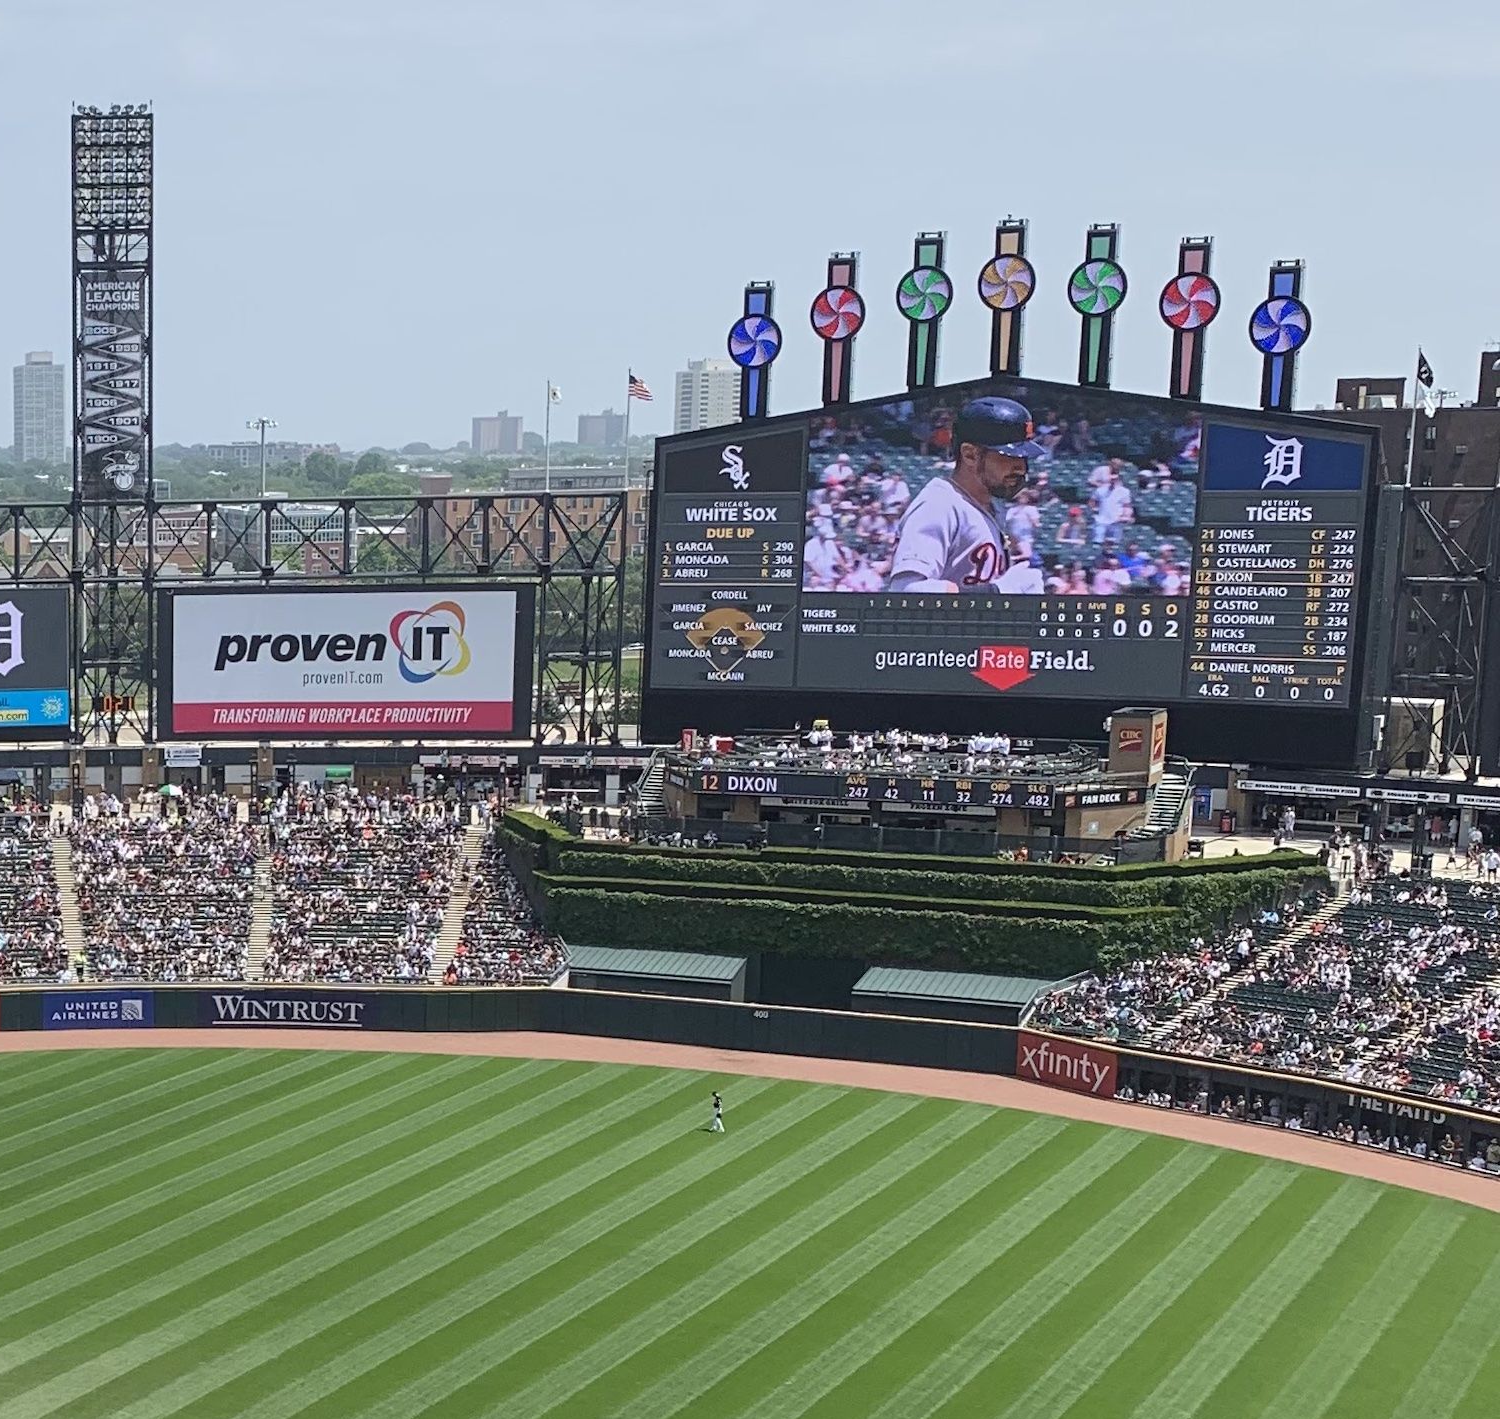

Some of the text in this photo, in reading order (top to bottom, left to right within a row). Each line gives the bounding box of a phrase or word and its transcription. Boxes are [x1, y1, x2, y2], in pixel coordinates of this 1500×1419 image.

[86, 282, 139, 290] AMERICAN
[86, 292, 139, 302] LEAGUE
[86, 303, 140, 311] CHAMPIONS
[686, 508, 777, 521] WHITE SOX
[1246, 507, 1312, 521] TIGERS
[706, 528, 754, 538] DUE UP
[1202, 529, 1355, 540] 21 JONES CF .247
[676, 542, 793, 551] GARCIA .290
[1201, 544, 1354, 554] 14 STEWART LF .224
[675, 555, 792, 564] MONCADA .304
[1202, 558, 1352, 569] 9 CASTELLANOS DH .276
[674, 569, 792, 577] ABREU .268
[1200, 572, 1352, 583] 12 DIXON .247
[712, 591, 748, 599] CORDELL
[1196, 586, 1350, 598] 46 CANDELARIO 3B .207
[671, 604, 706, 612] JIMENEZ
[756, 604, 772, 612] JAY
[1114, 604, 1178, 615] B S O
[1196, 600, 1349, 612] 30 CASTRO RF .272
[803, 610, 837, 618] TIGERS
[1194, 614, 1348, 626] 28 GOODRUM 2B .234
[673, 622, 704, 630] GARCIA
[745, 622, 782, 631] SANCHEZ
[802, 624, 856, 633] WHITE SOX
[1113, 620, 1178, 637] 0 0 2
[1194, 628, 1347, 641] 55 HICKS C .187
[712, 637, 737, 645] CEASE
[214, 626, 450, 670] proven IT
[1196, 642, 1346, 656] 7 MERCER SS .206
[668, 650, 711, 658] MONCADA
[746, 650, 773, 658] ABREU
[876, 650, 1095, 671] guaranteed Rate Field.
[1190, 662, 1295, 674] 44 DANIEL NORRIS
[303, 671, 383, 687] provenIT.com
[708, 673, 744, 681] MCCANN
[1199, 684, 1229, 697] 4.62
[213, 707, 471, 724] TRANSFORMING WORKPLACE PRODUCTIVITY
[1121, 731, 1141, 739] CIBC
[701, 775, 777, 792] 12 DIXON
[847, 777, 1046, 793] AVG RBI SLG
[845, 788, 1049, 806] .247 42 11 32 .274 .482
[1082, 794, 1120, 804] FAN DECK
[65, 1001, 118, 1010] UNITED
[212, 994, 364, 1022] WINTRUST
[52, 1011, 118, 1020] AIRLINES
[1021, 1042, 1110, 1092] xfinity
